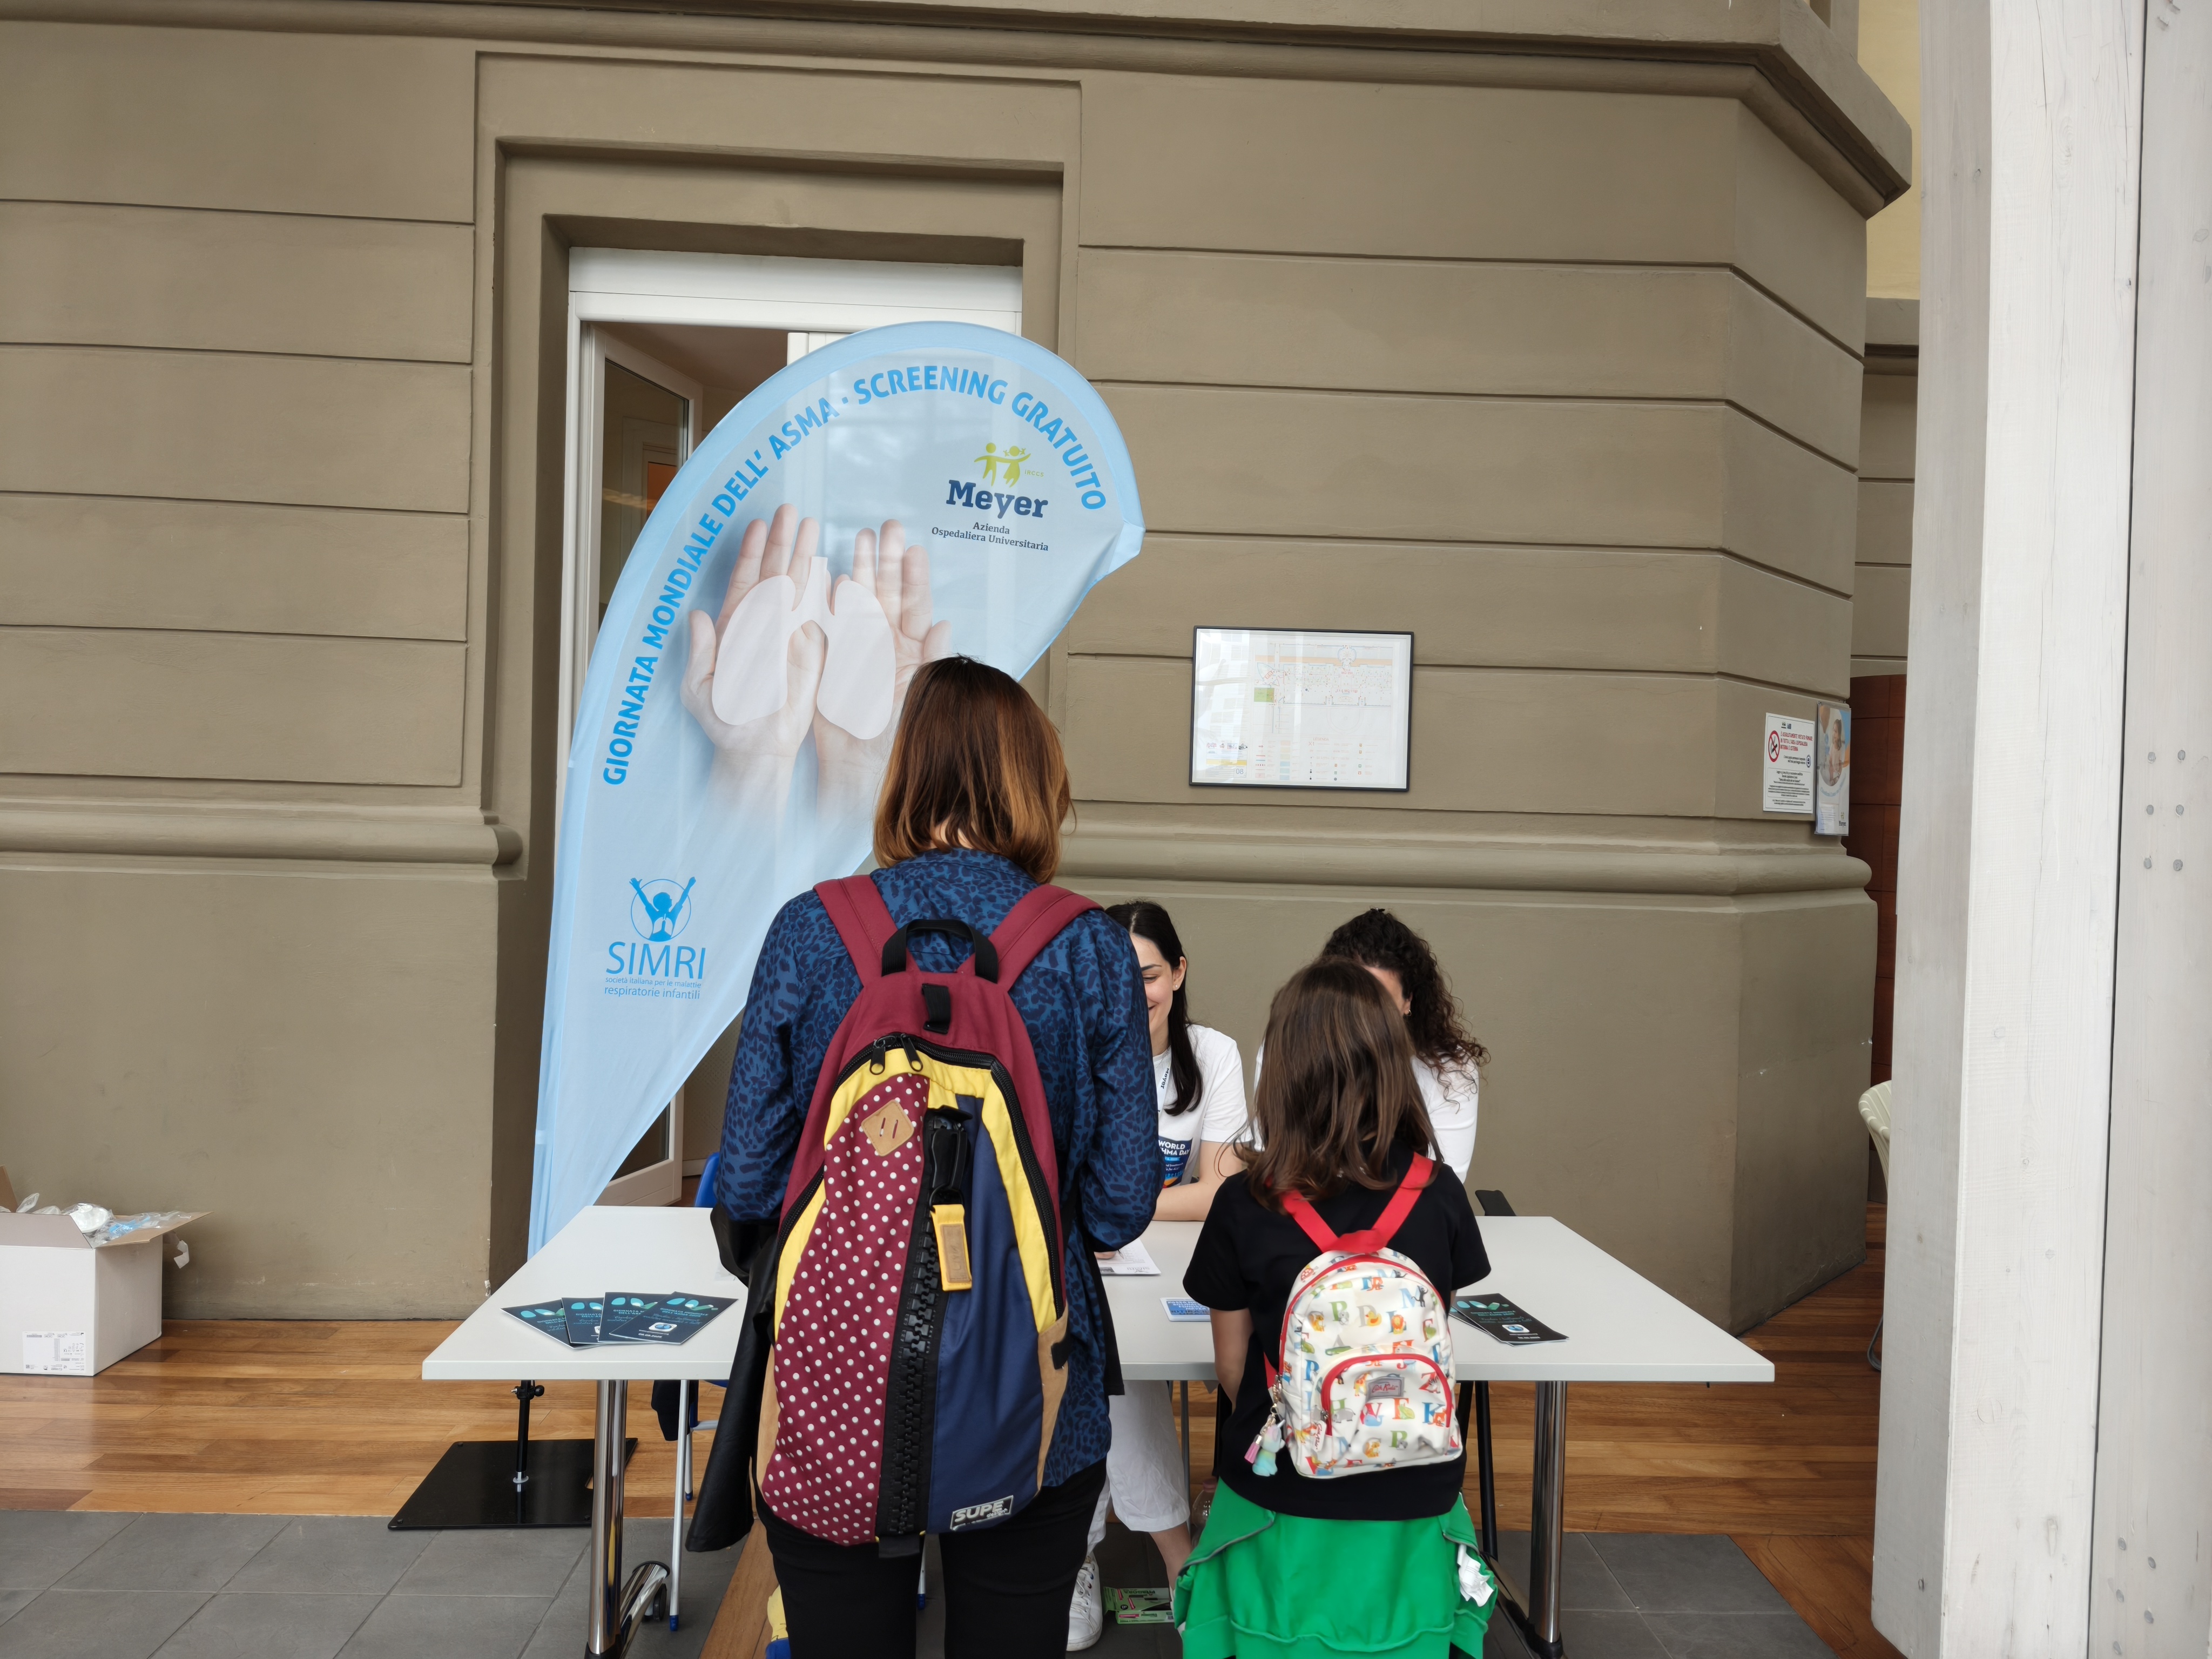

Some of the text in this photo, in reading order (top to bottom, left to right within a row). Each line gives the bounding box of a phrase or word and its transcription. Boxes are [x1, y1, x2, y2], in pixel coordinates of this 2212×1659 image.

[853, 366, 1106, 510] SCREENING GRATUITO
[1024, 469, 1044, 477] IRCCS
[946, 480, 1048, 519] Meyer
[932, 527, 1048, 551] Ospedaliera Universitaria
[973, 522, 1010, 535] Azienda
[603, 656, 659, 785] GIORNATA
[642, 514, 724, 650] MONDIALE
[768, 397, 840, 460] ASMA
[606, 941, 706, 979] SIMRI
[604, 987, 700, 999] respiratorie infantili
[1158, 1139, 1185, 1150] WORLD
[954, 1500, 1004, 1522] SUPE
